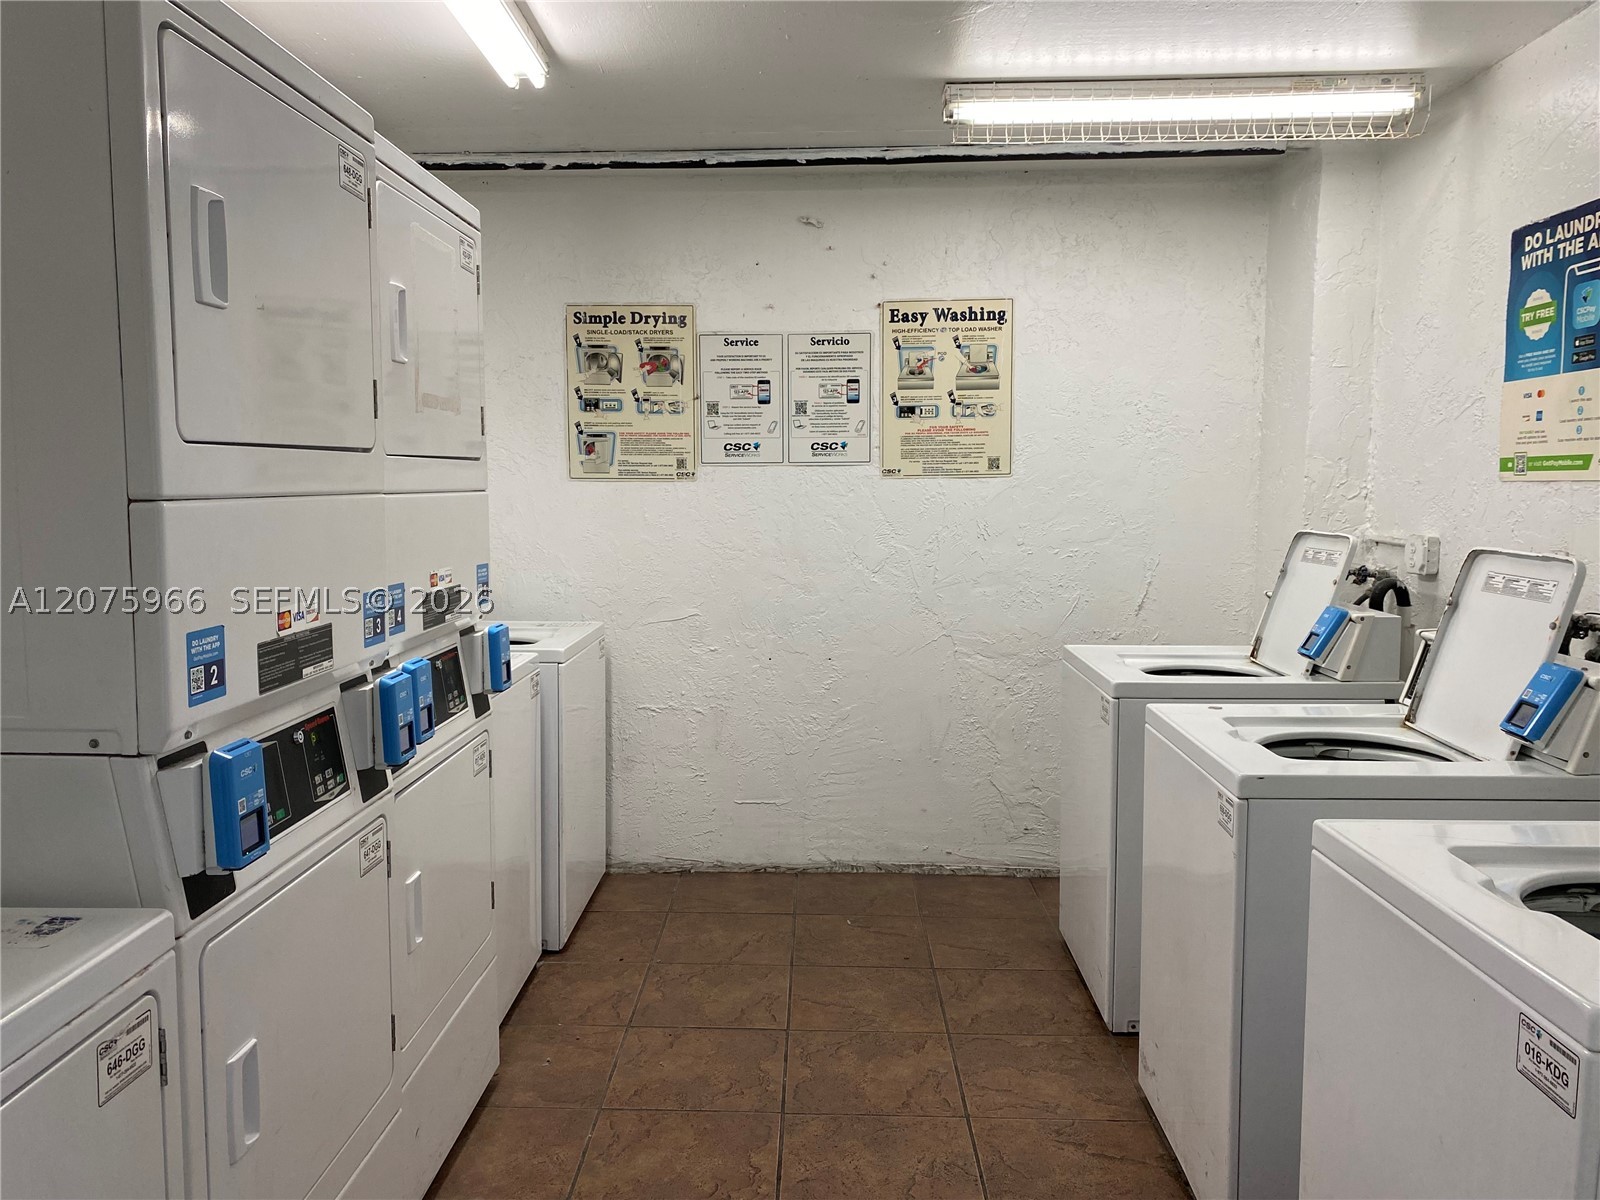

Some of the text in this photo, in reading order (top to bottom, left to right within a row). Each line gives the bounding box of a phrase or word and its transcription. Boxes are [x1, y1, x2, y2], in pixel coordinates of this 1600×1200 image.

[1525, 232, 1543, 252] DO
[1521, 232, 1600, 271] WITH THE A
[573, 311, 687, 328] Simple Drying
[889, 306, 1008, 327] Easy Washing
[1521, 306, 1555, 322] TRY FREE
[723, 337, 759, 347] Service
[810, 336, 850, 346] Servicio
[723, 442, 752, 451] CSC
[810, 442, 839, 451] CSC
[293, 611, 304, 622] VISA
[397, 609, 402, 622] 4
[376, 618, 382, 633] 3
[203, 643, 212, 652] THE
[212, 641, 220, 649] APP
[210, 665, 218, 686] 2
[240, 766, 253, 777] CSC
[1521, 1018, 1536, 1034] CSC
[99, 1041, 113, 1056] CSC
[106, 1038, 146, 1076] 646-DGG
[1525, 1042, 1569, 1088] 016-KDG
